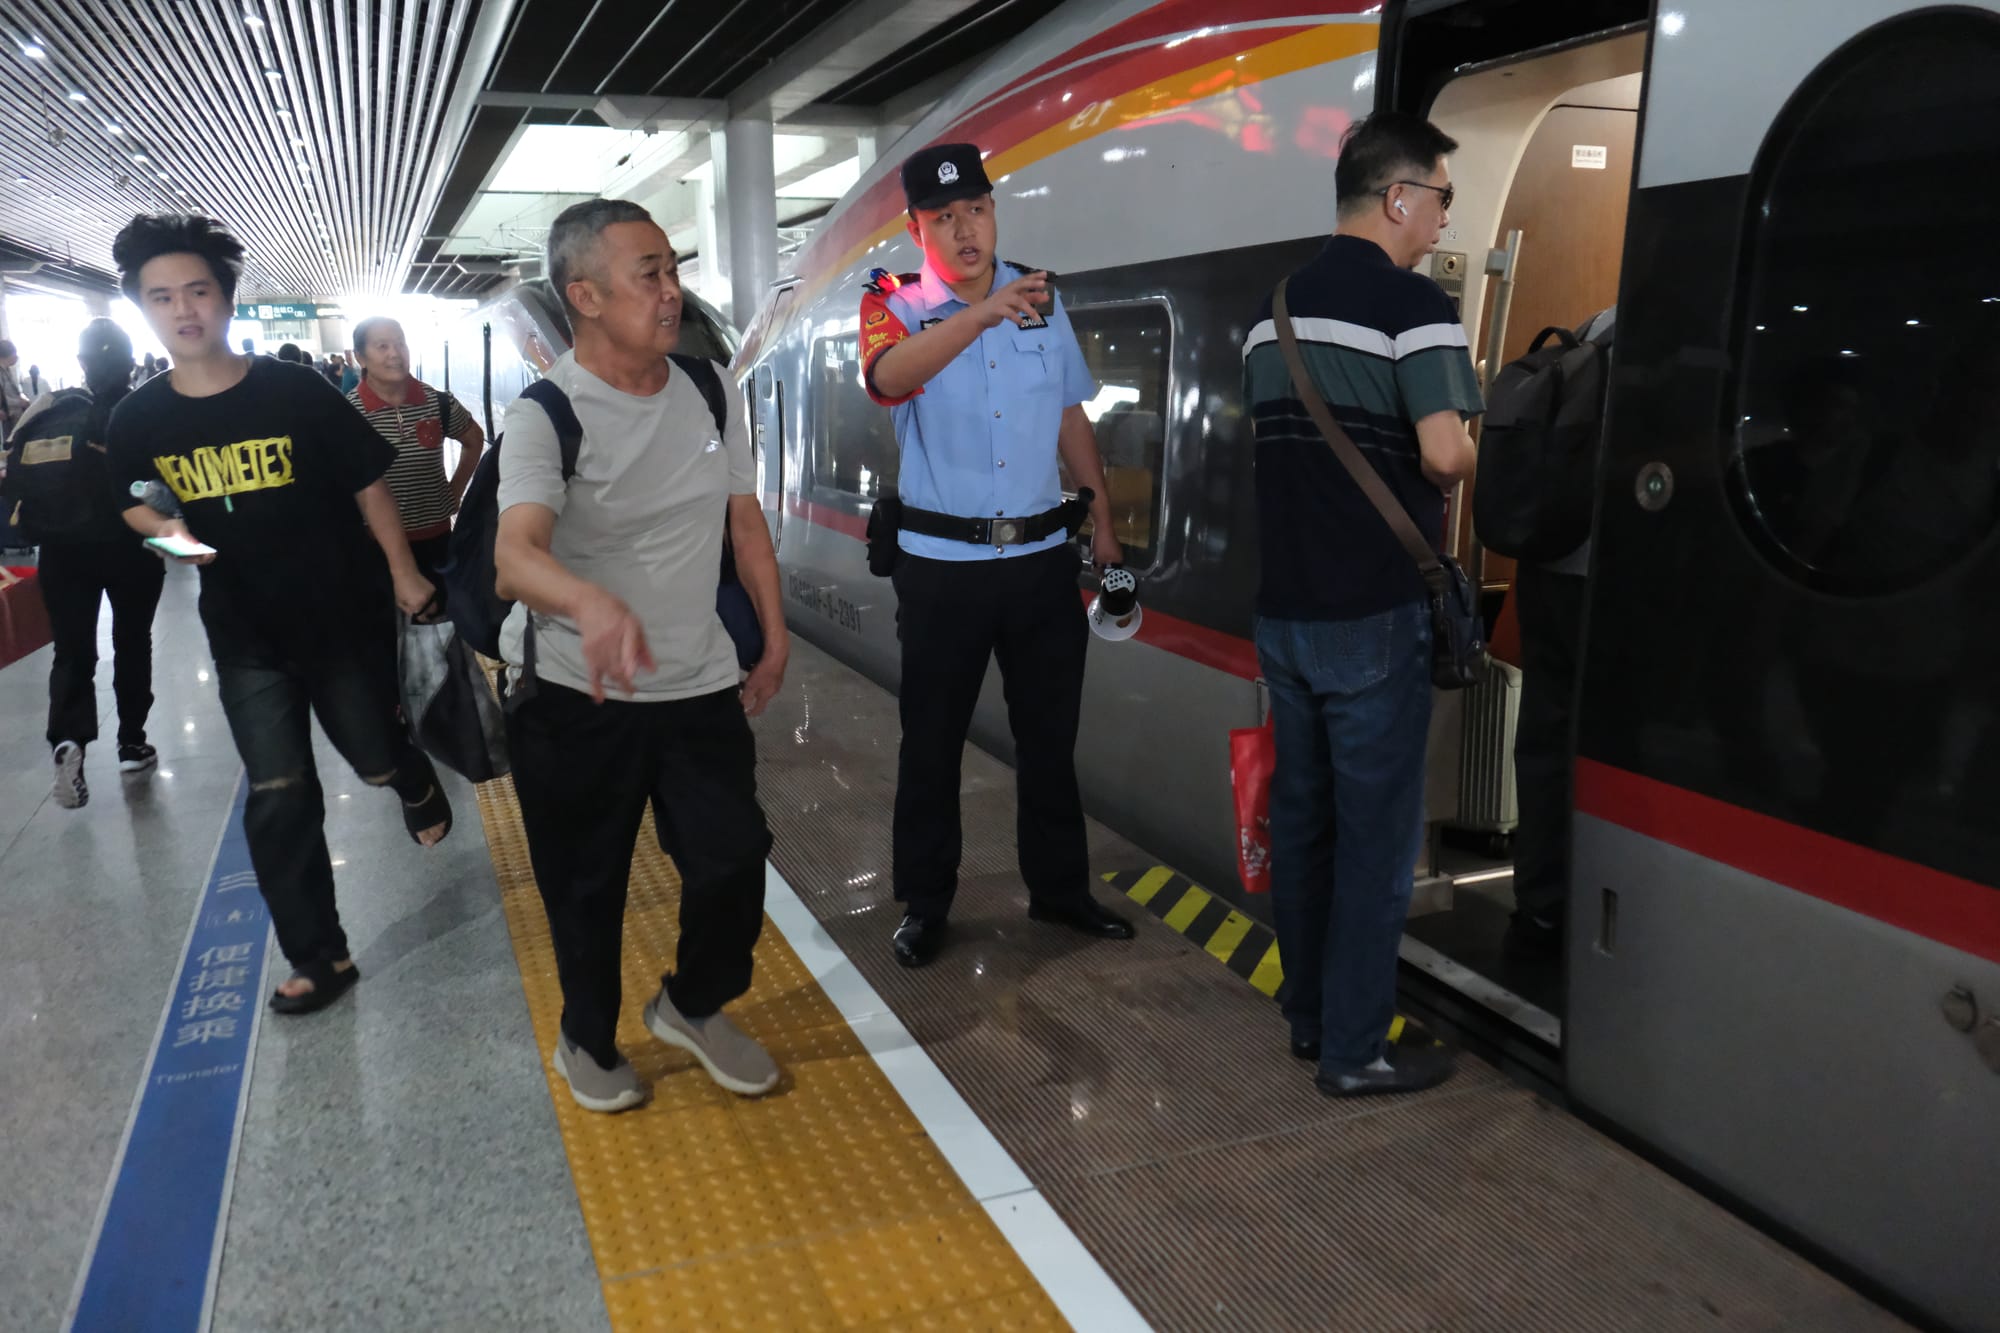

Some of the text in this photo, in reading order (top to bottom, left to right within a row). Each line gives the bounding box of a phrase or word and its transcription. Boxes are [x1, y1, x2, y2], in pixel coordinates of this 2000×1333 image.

[173, 942, 254, 1048] 便捷换乘
[156, 1063, 241, 1085] Transfer
